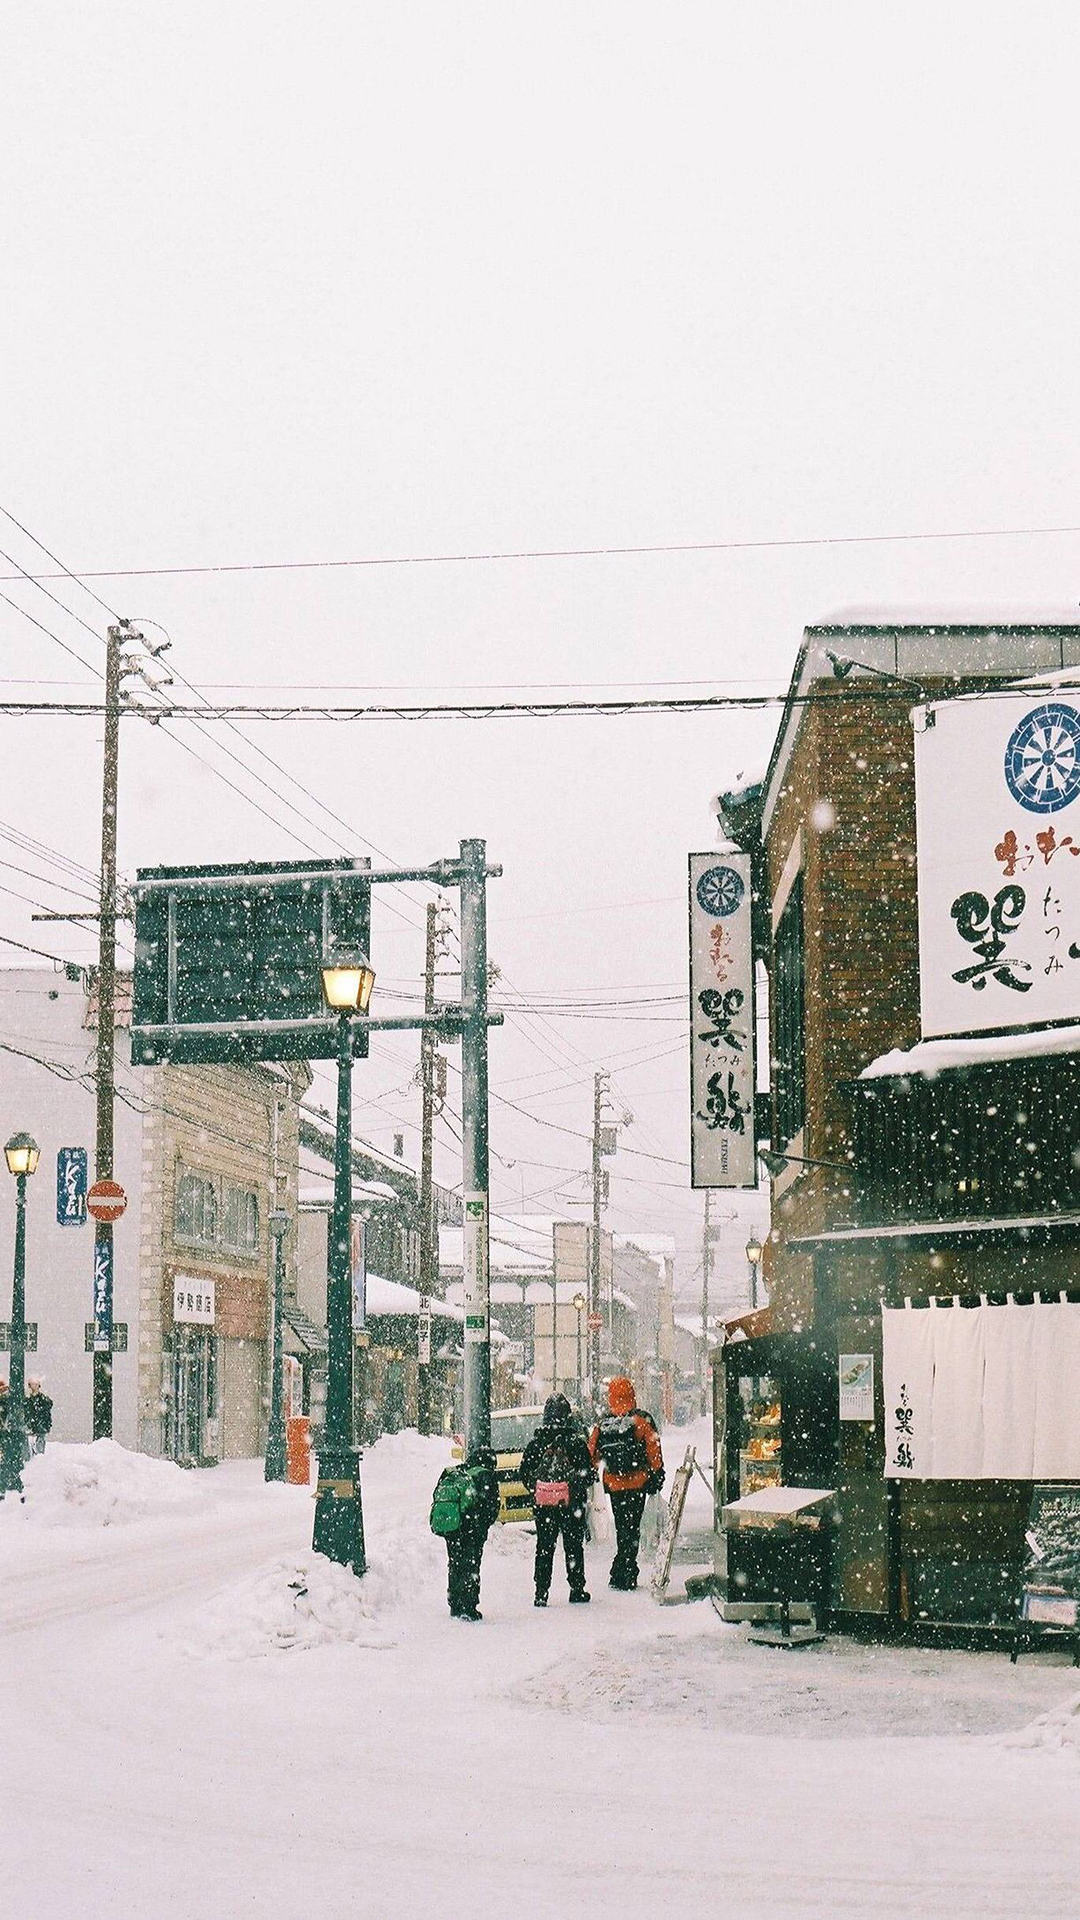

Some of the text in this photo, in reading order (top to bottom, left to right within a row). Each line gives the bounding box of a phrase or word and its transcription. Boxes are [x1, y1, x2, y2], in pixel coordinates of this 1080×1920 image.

[709, 923, 733, 982] おたる
[950, 884, 1033, 993] 巽
[1043, 886, 1063, 976] たつみ
[698, 988, 747, 1052] 巽
[705, 1053, 741, 1068] たつみ
